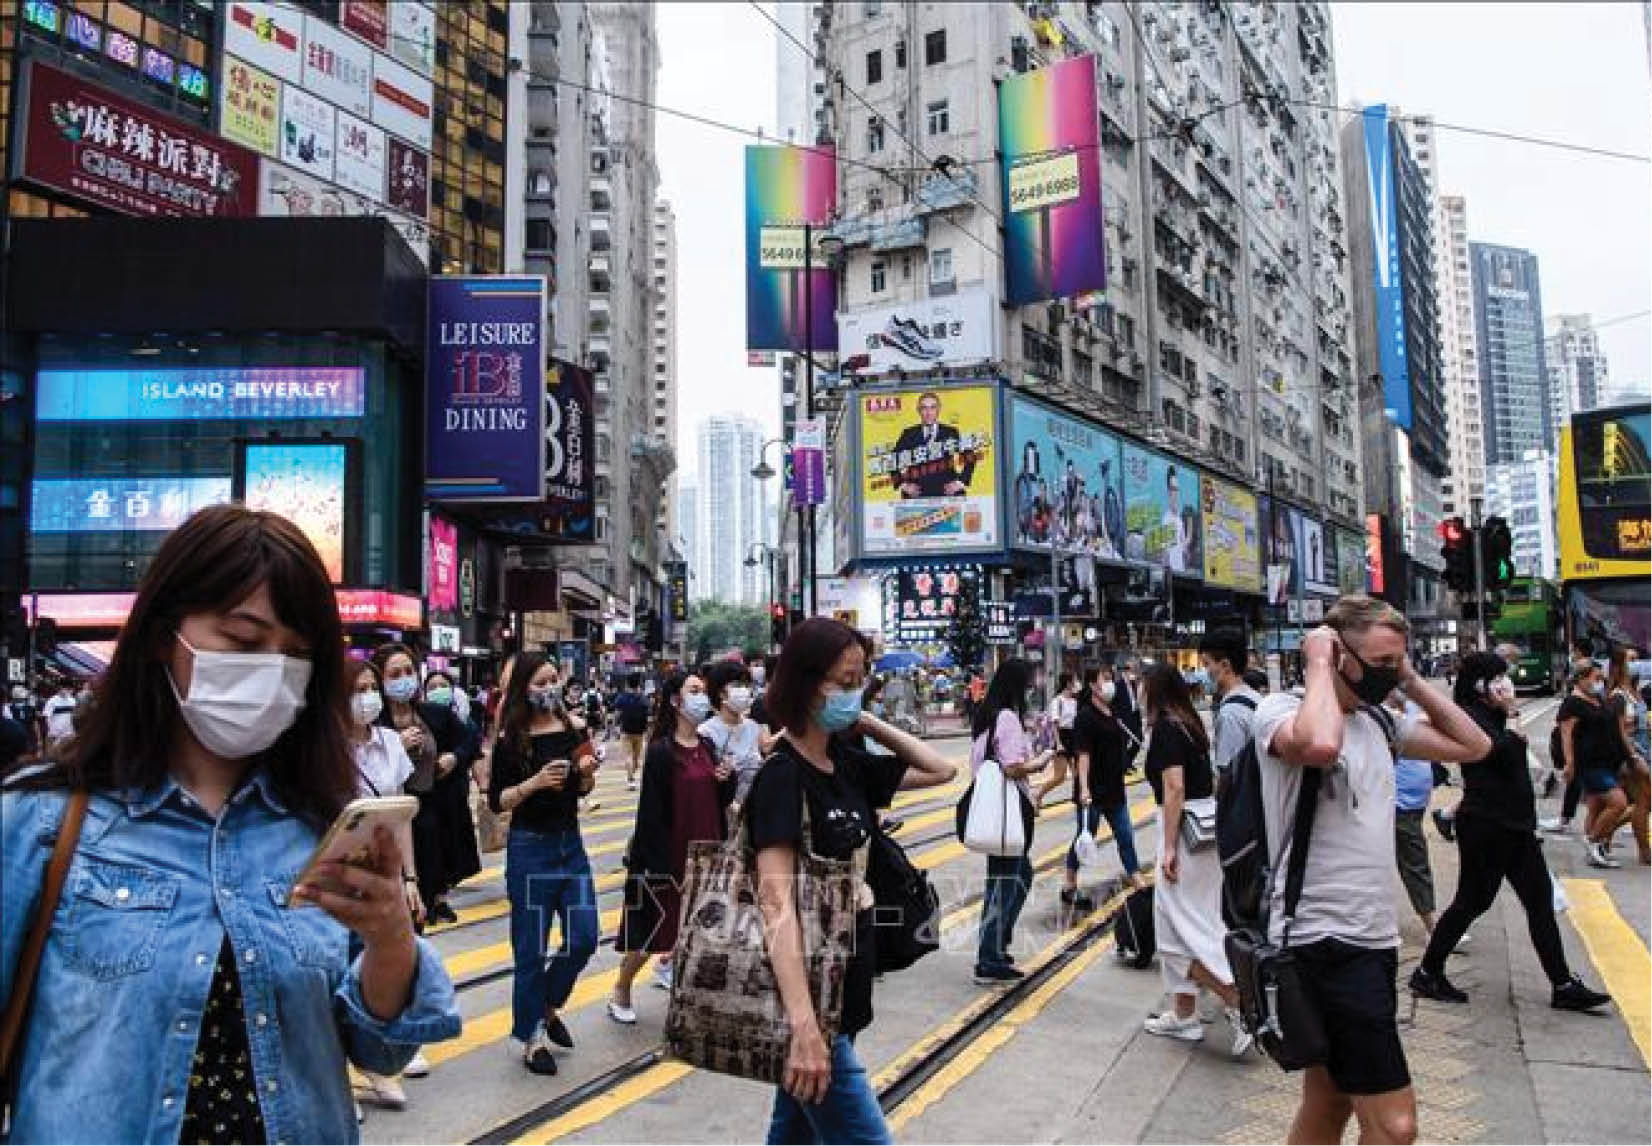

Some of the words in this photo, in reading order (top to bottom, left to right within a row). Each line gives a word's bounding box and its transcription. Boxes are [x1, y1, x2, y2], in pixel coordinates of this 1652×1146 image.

[440, 322, 536, 345] LEISURE
[142, 381, 225, 399] ISLAND
[234, 381, 339, 399] BEVERLEY
[445, 407, 529, 430] DINING
